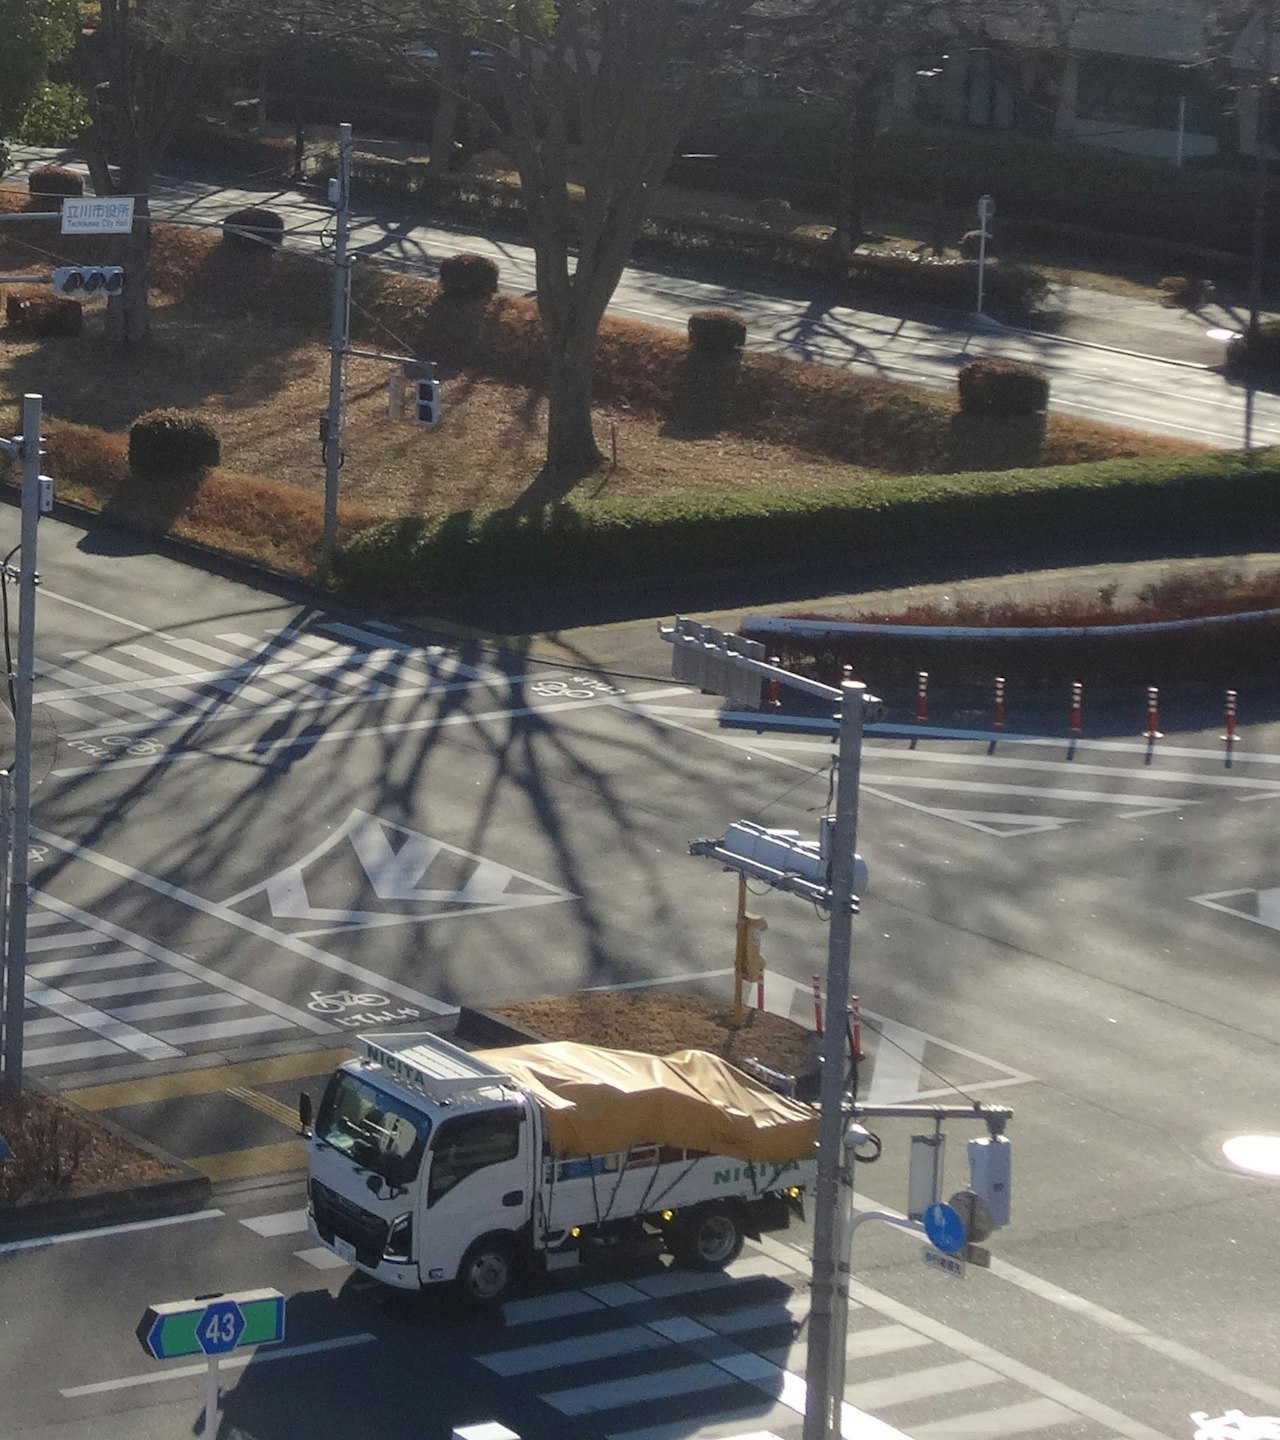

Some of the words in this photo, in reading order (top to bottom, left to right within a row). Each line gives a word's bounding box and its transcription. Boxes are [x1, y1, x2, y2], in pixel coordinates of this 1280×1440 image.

[67, 203, 130, 219] 立川市役所
[206, 1313, 235, 1343] 43
